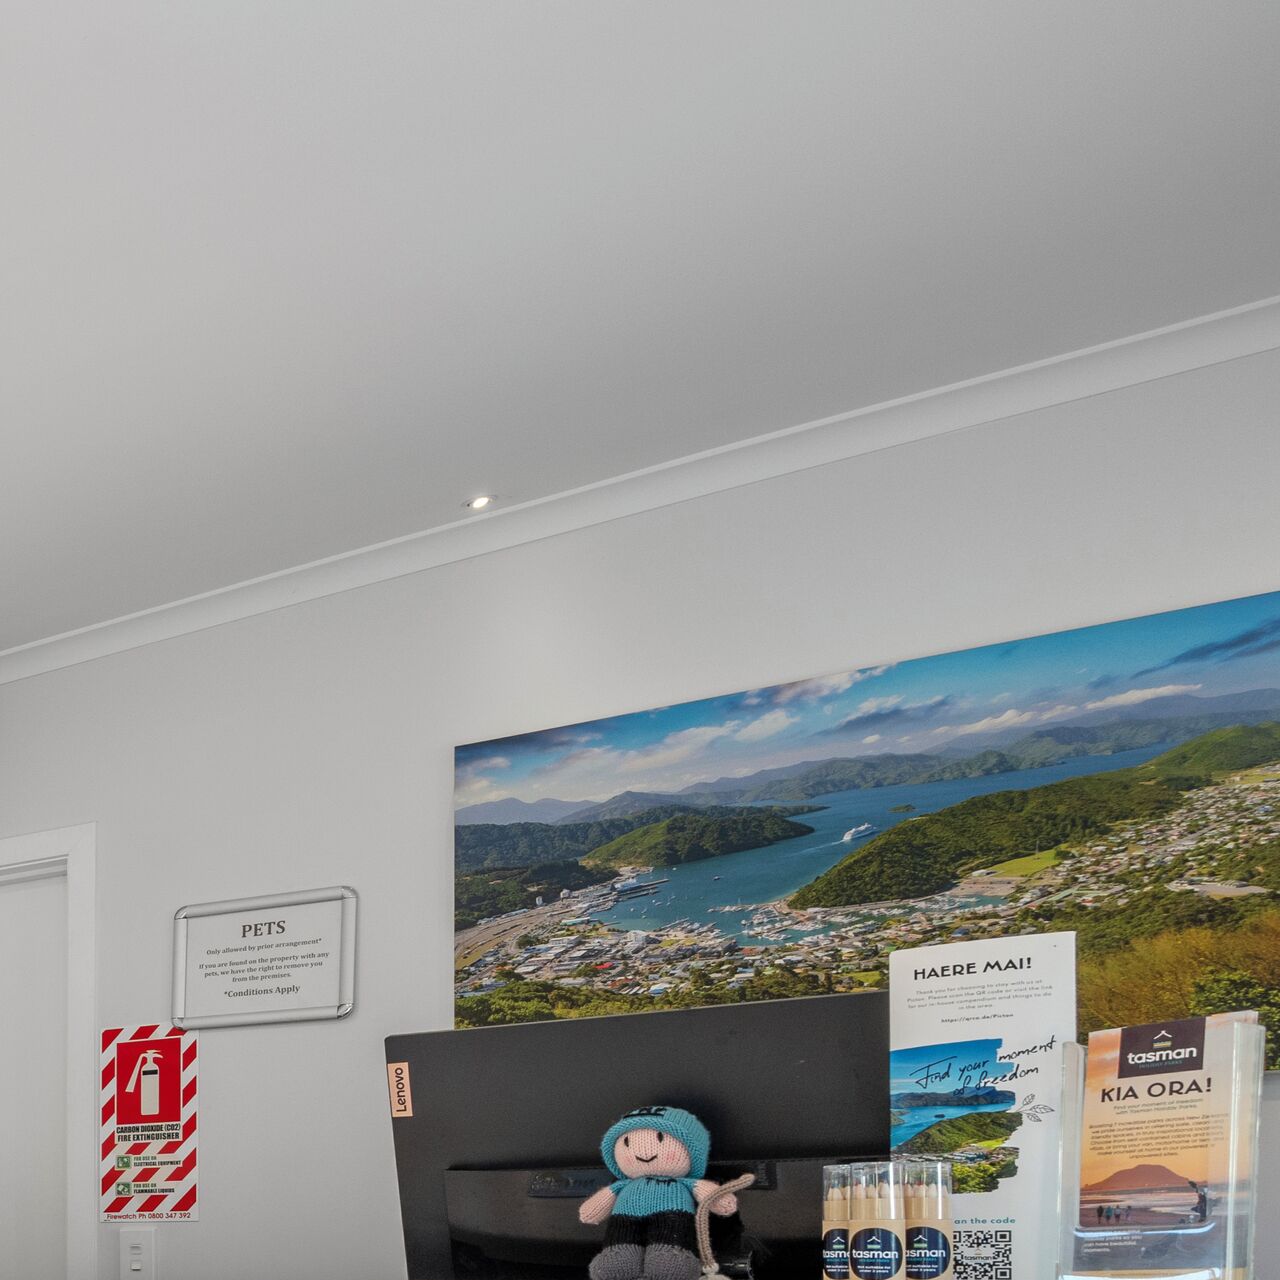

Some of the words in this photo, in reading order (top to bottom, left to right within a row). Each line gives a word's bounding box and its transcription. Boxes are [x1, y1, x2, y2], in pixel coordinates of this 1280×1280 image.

[241, 920, 286, 938] PETS
[222, 946, 247, 954] allowed
[257, 943, 273, 951] prior
[270, 955, 299, 964] property
[258, 964, 274, 972] right
[914, 962, 977, 980] HAERE
[982, 957, 1031, 973] MAI!
[260, 972, 291, 981] premises.
[275, 985, 300, 994] Apply
[1127, 1047, 1197, 1064] tasman
[909, 1055, 957, 1089] Find
[958, 1060, 989, 1081] your
[999, 1035, 1056, 1062] moment
[953, 1077, 971, 1096] of
[975, 1063, 1039, 1090] freedom
[396, 1066, 408, 1113] Lenovo
[1101, 1085, 1139, 1102] KIA
[1147, 1077, 1212, 1098] ORA!
[116, 1125, 139, 1133] CARBON
[141, 1124, 163, 1132] DIOXIDE
[165, 1123, 181, 1131] (CO2)
[133, 1132, 179, 1141] EXTINGUISHER
[852, 1249, 898, 1258] tasman
